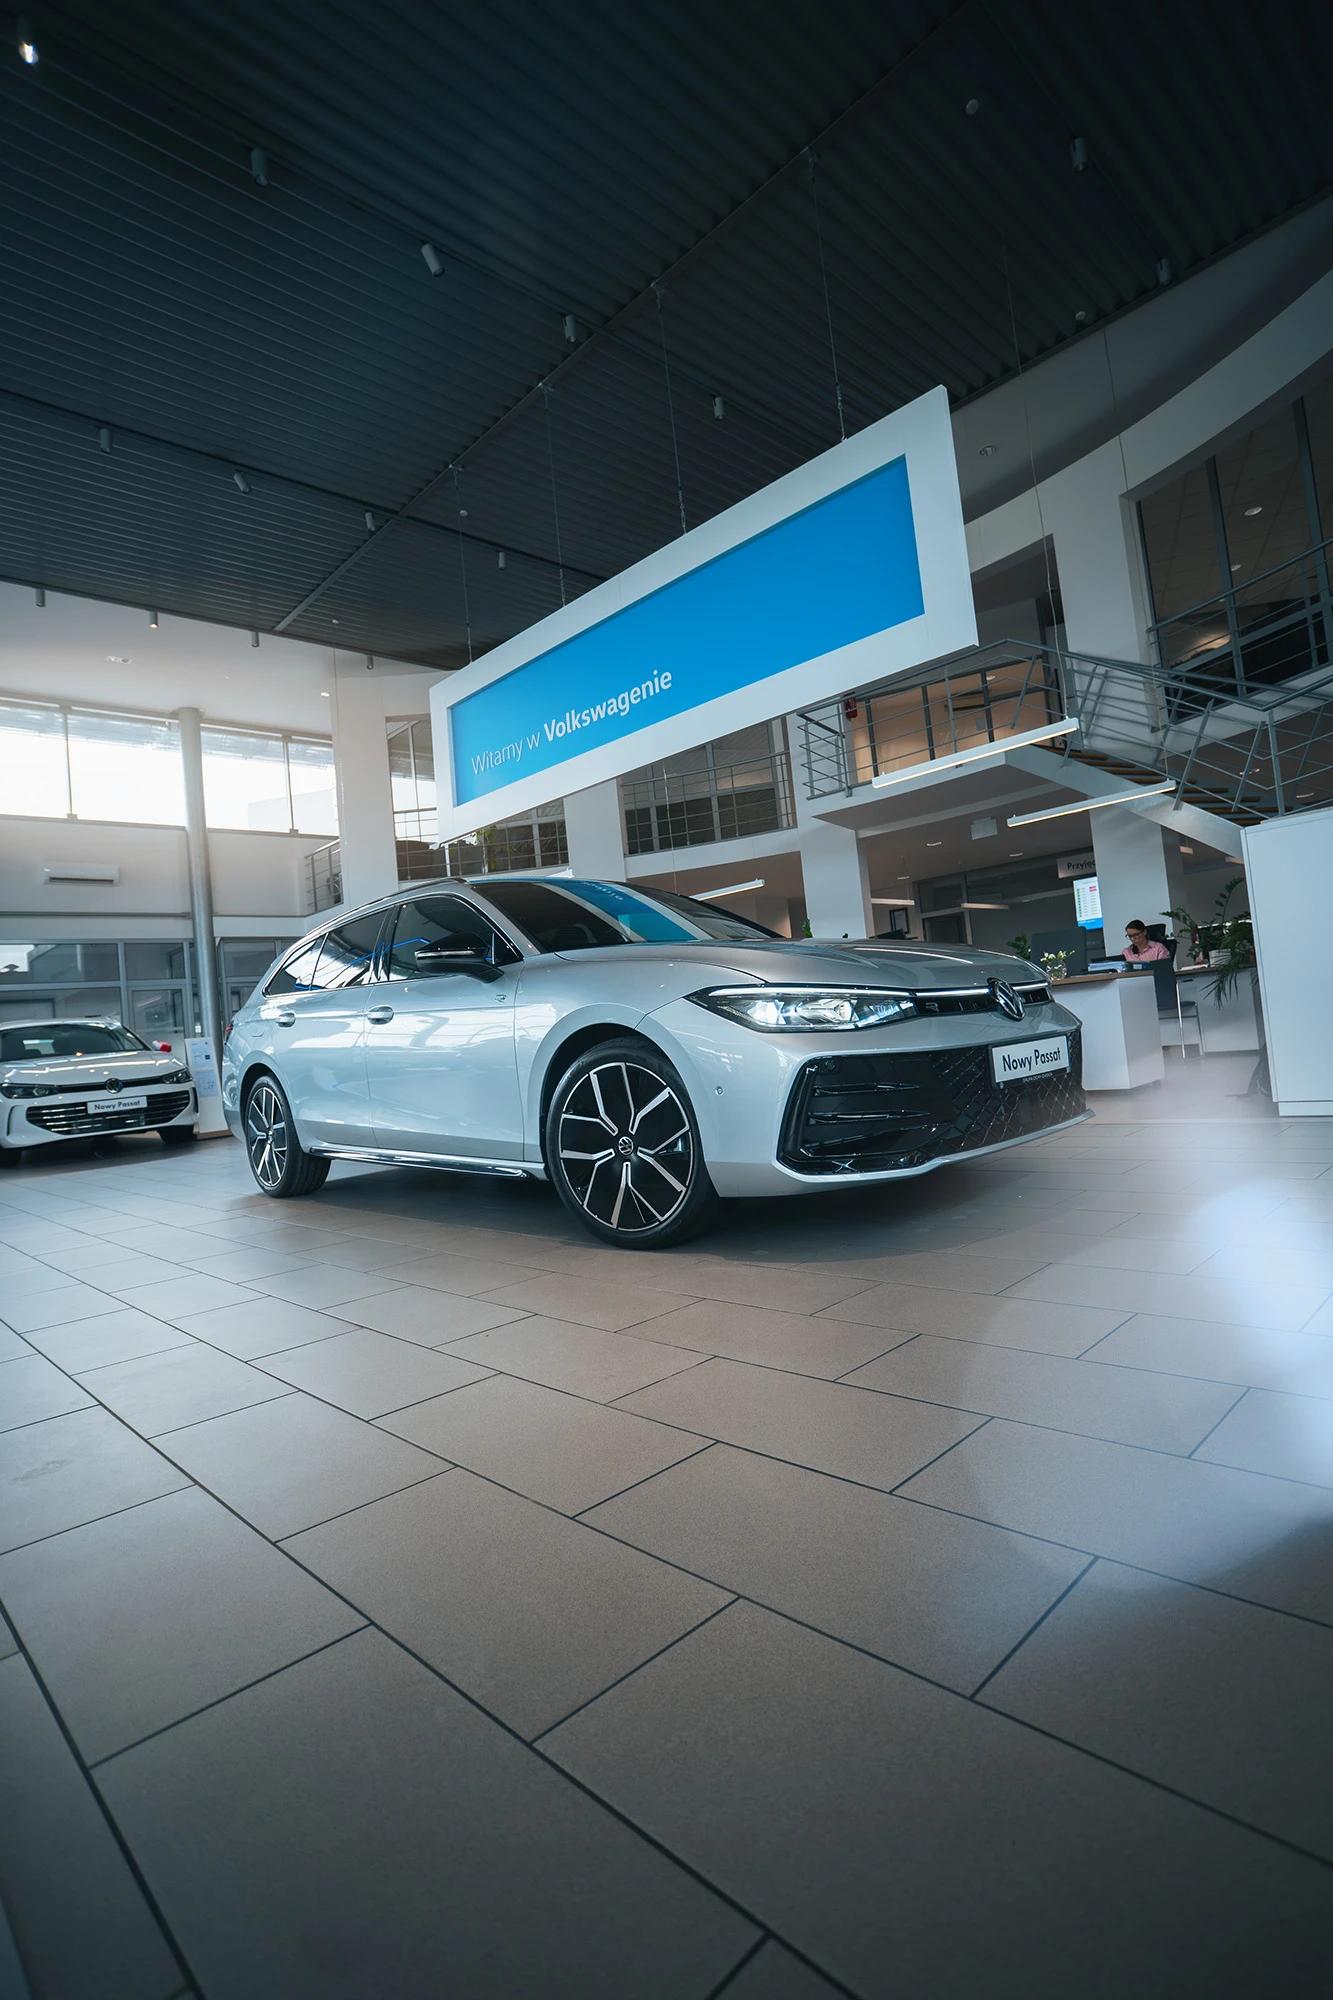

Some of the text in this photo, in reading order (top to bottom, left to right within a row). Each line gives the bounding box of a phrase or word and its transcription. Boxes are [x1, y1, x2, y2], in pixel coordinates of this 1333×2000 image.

[471, 669, 673, 775] Witamy w Volkswagenie
[1002, 1048, 1061, 1072] Nowy Passat
